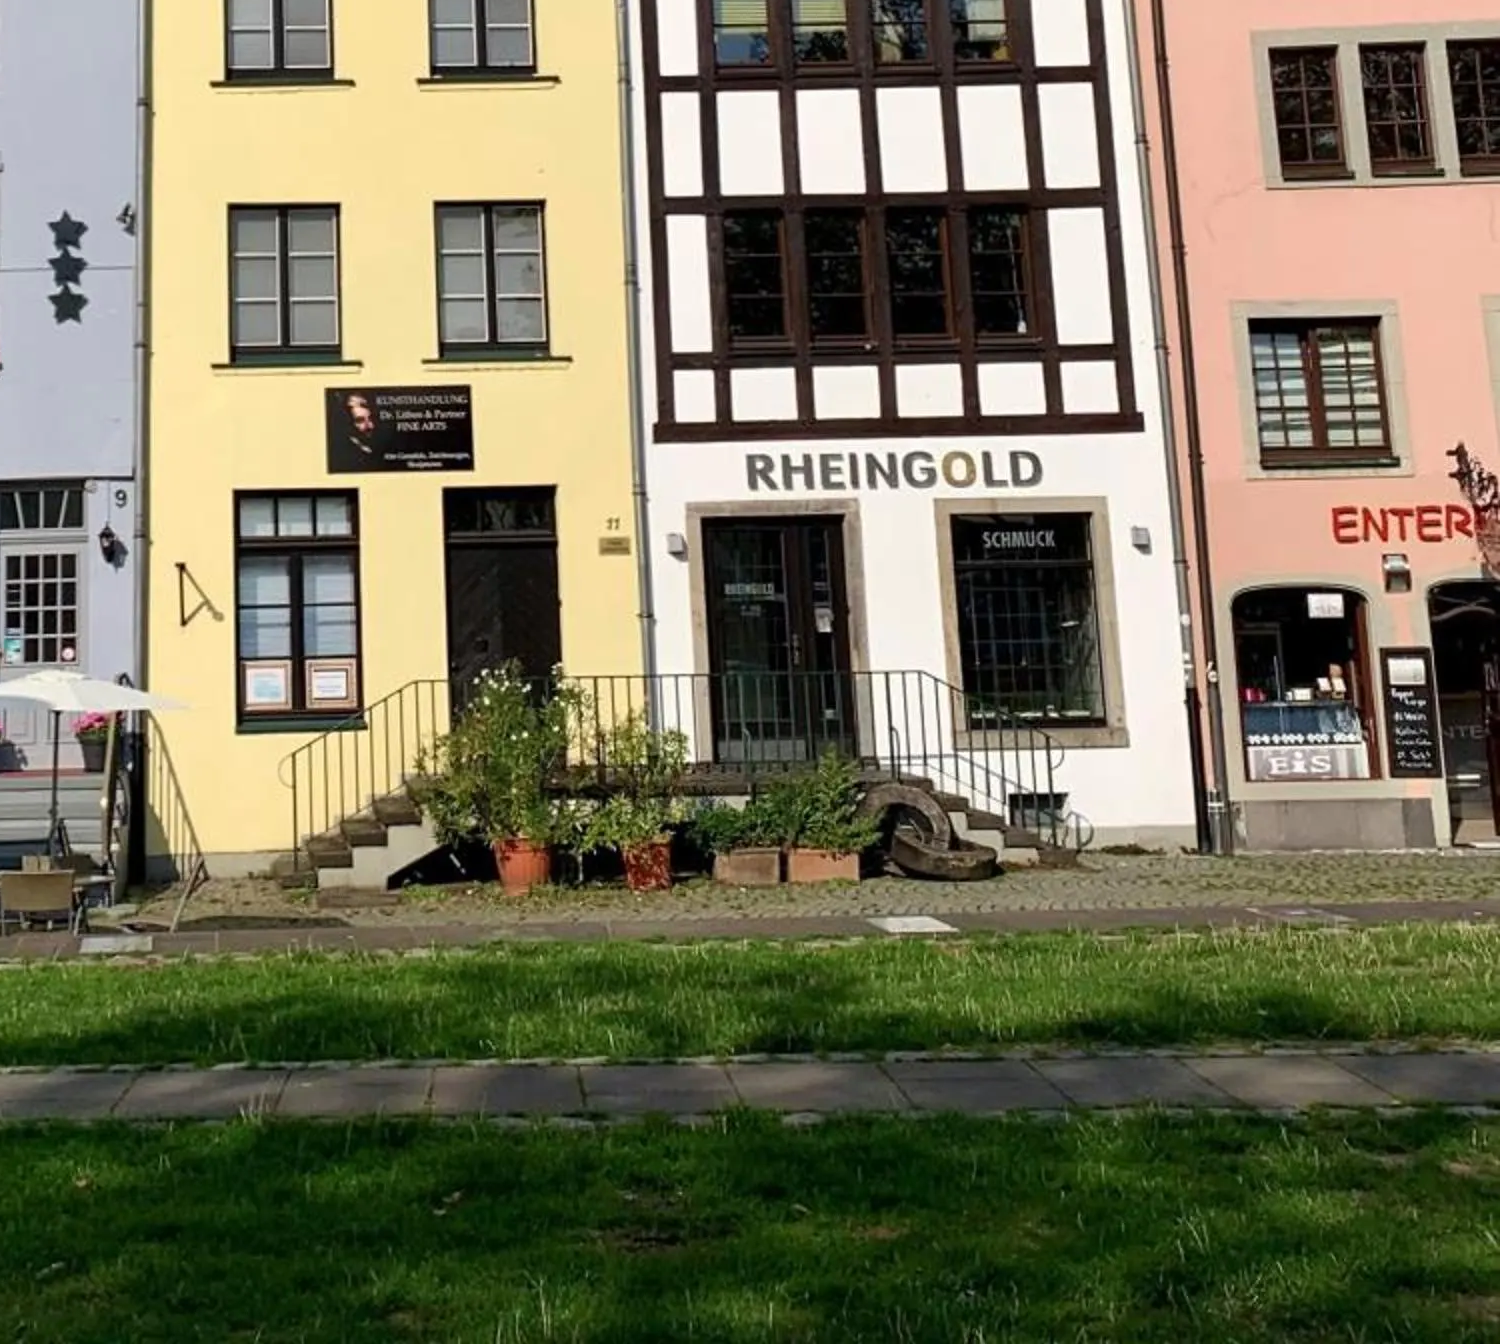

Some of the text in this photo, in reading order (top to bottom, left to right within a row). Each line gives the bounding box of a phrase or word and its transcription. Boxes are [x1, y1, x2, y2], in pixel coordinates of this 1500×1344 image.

[397, 422, 447, 431] FINE ARTS
[746, 451, 1043, 491] RHEINGOLD
[115, 489, 127, 508] 9
[1332, 503, 1486, 545] ENTER
[982, 530, 1056, 549] SCHMUCK
